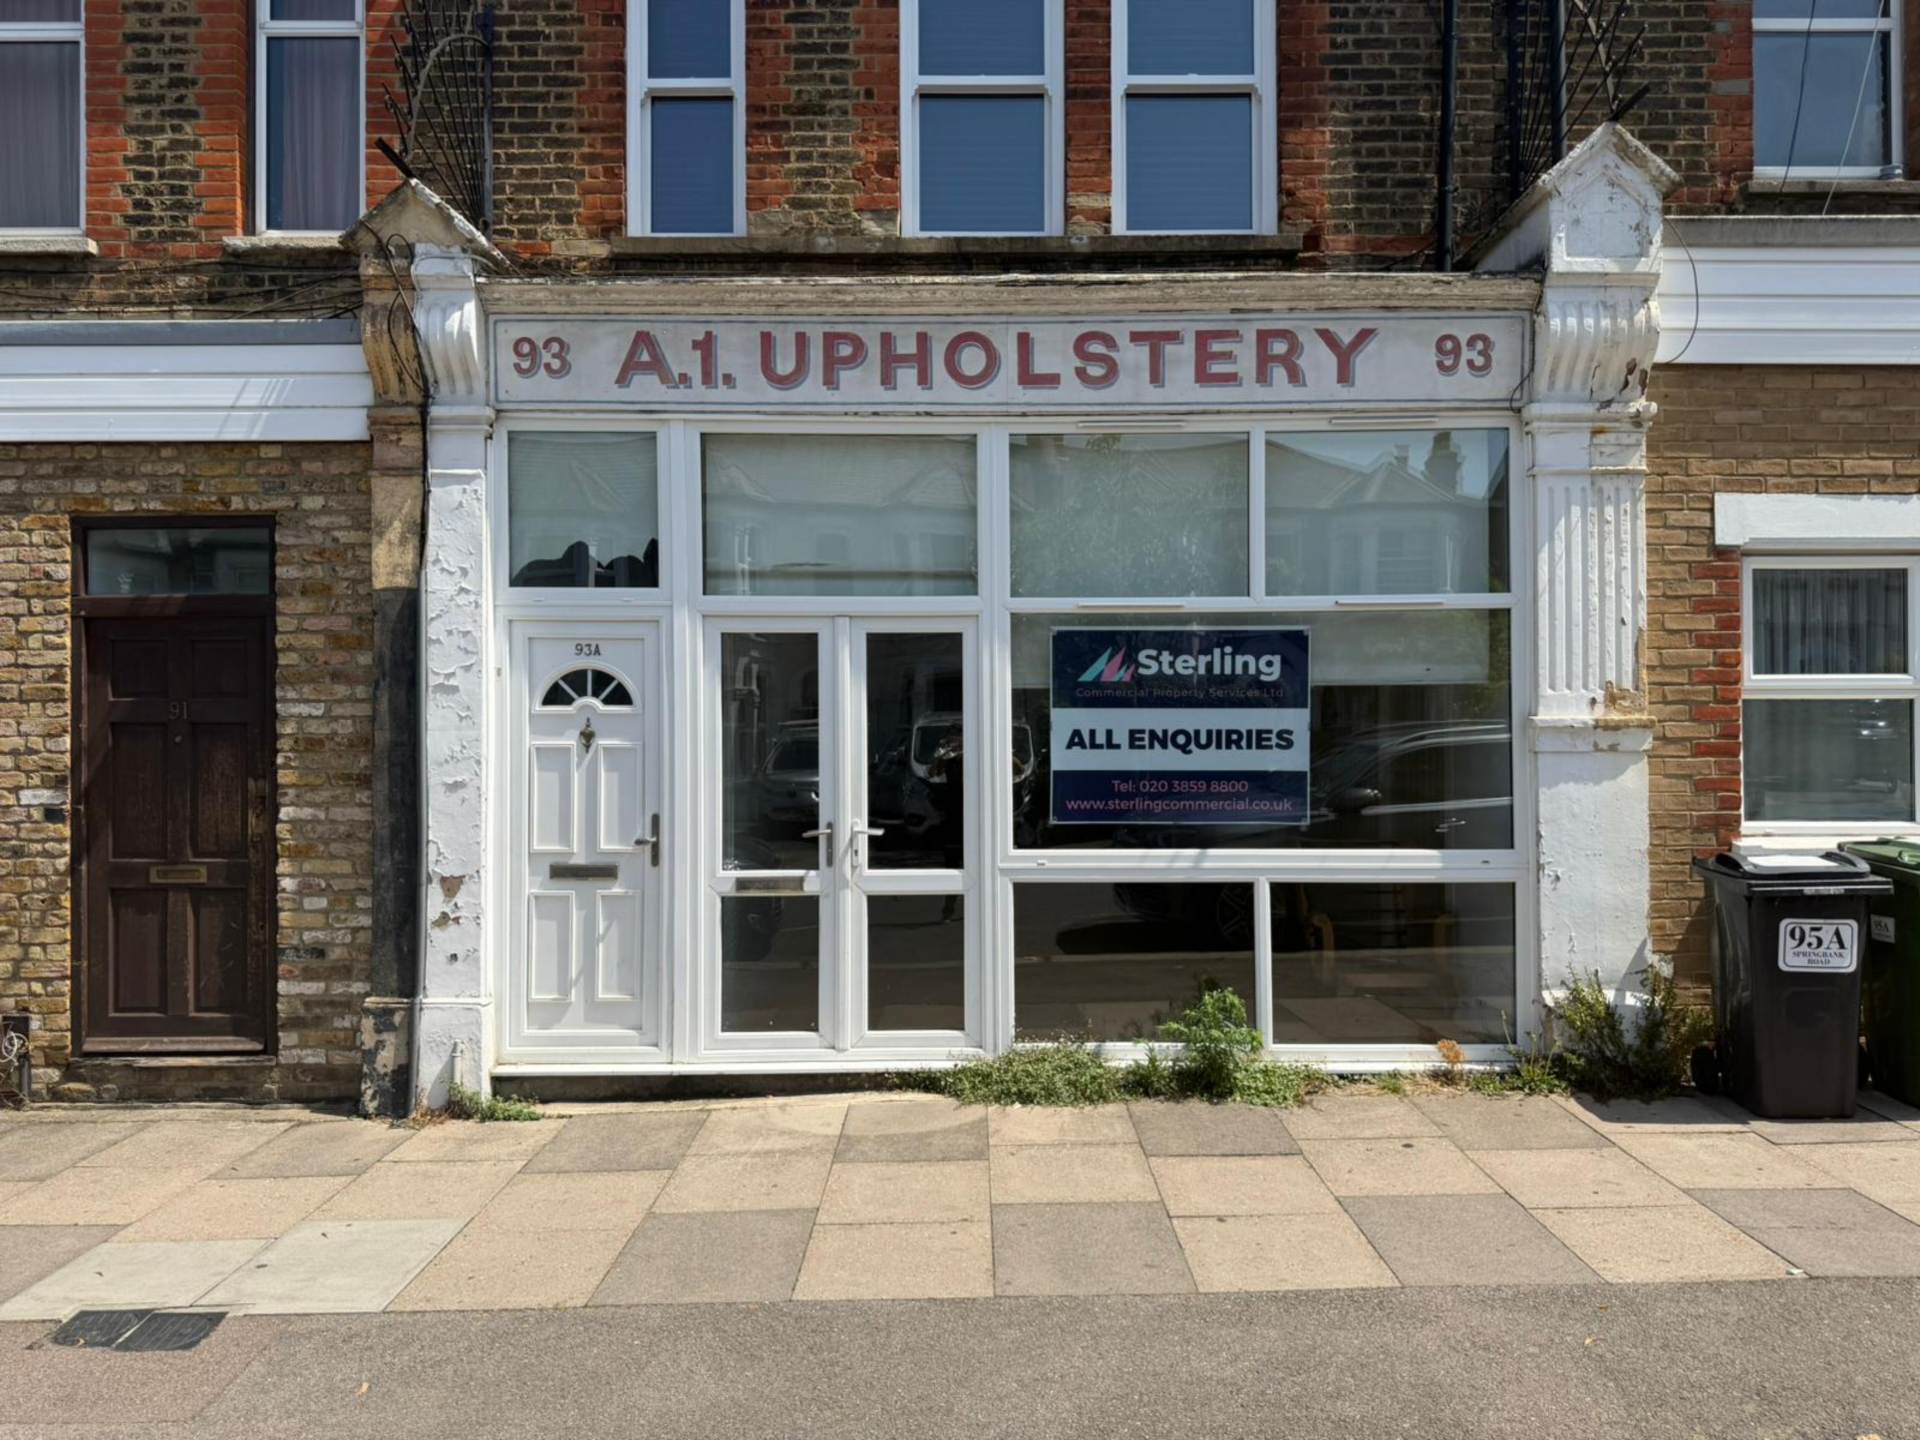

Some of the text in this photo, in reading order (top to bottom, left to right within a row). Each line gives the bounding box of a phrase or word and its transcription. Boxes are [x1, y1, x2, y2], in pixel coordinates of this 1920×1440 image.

[512, 327, 1493, 389] 93 A.1. UPHOLSTERY 93
[575, 643, 601, 656] 93A
[1137, 646, 1281, 681] Sterling
[1076, 687, 1283, 700] Commercial Property Services Ltd
[1065, 728, 1294, 754] ALL ENQUIRIES
[1112, 780, 1249, 792] Tel: 020 3859 8800
[1066, 798, 1292, 813] www.sterlingcommercial.co.uk
[1789, 925, 1847, 950] 95A
